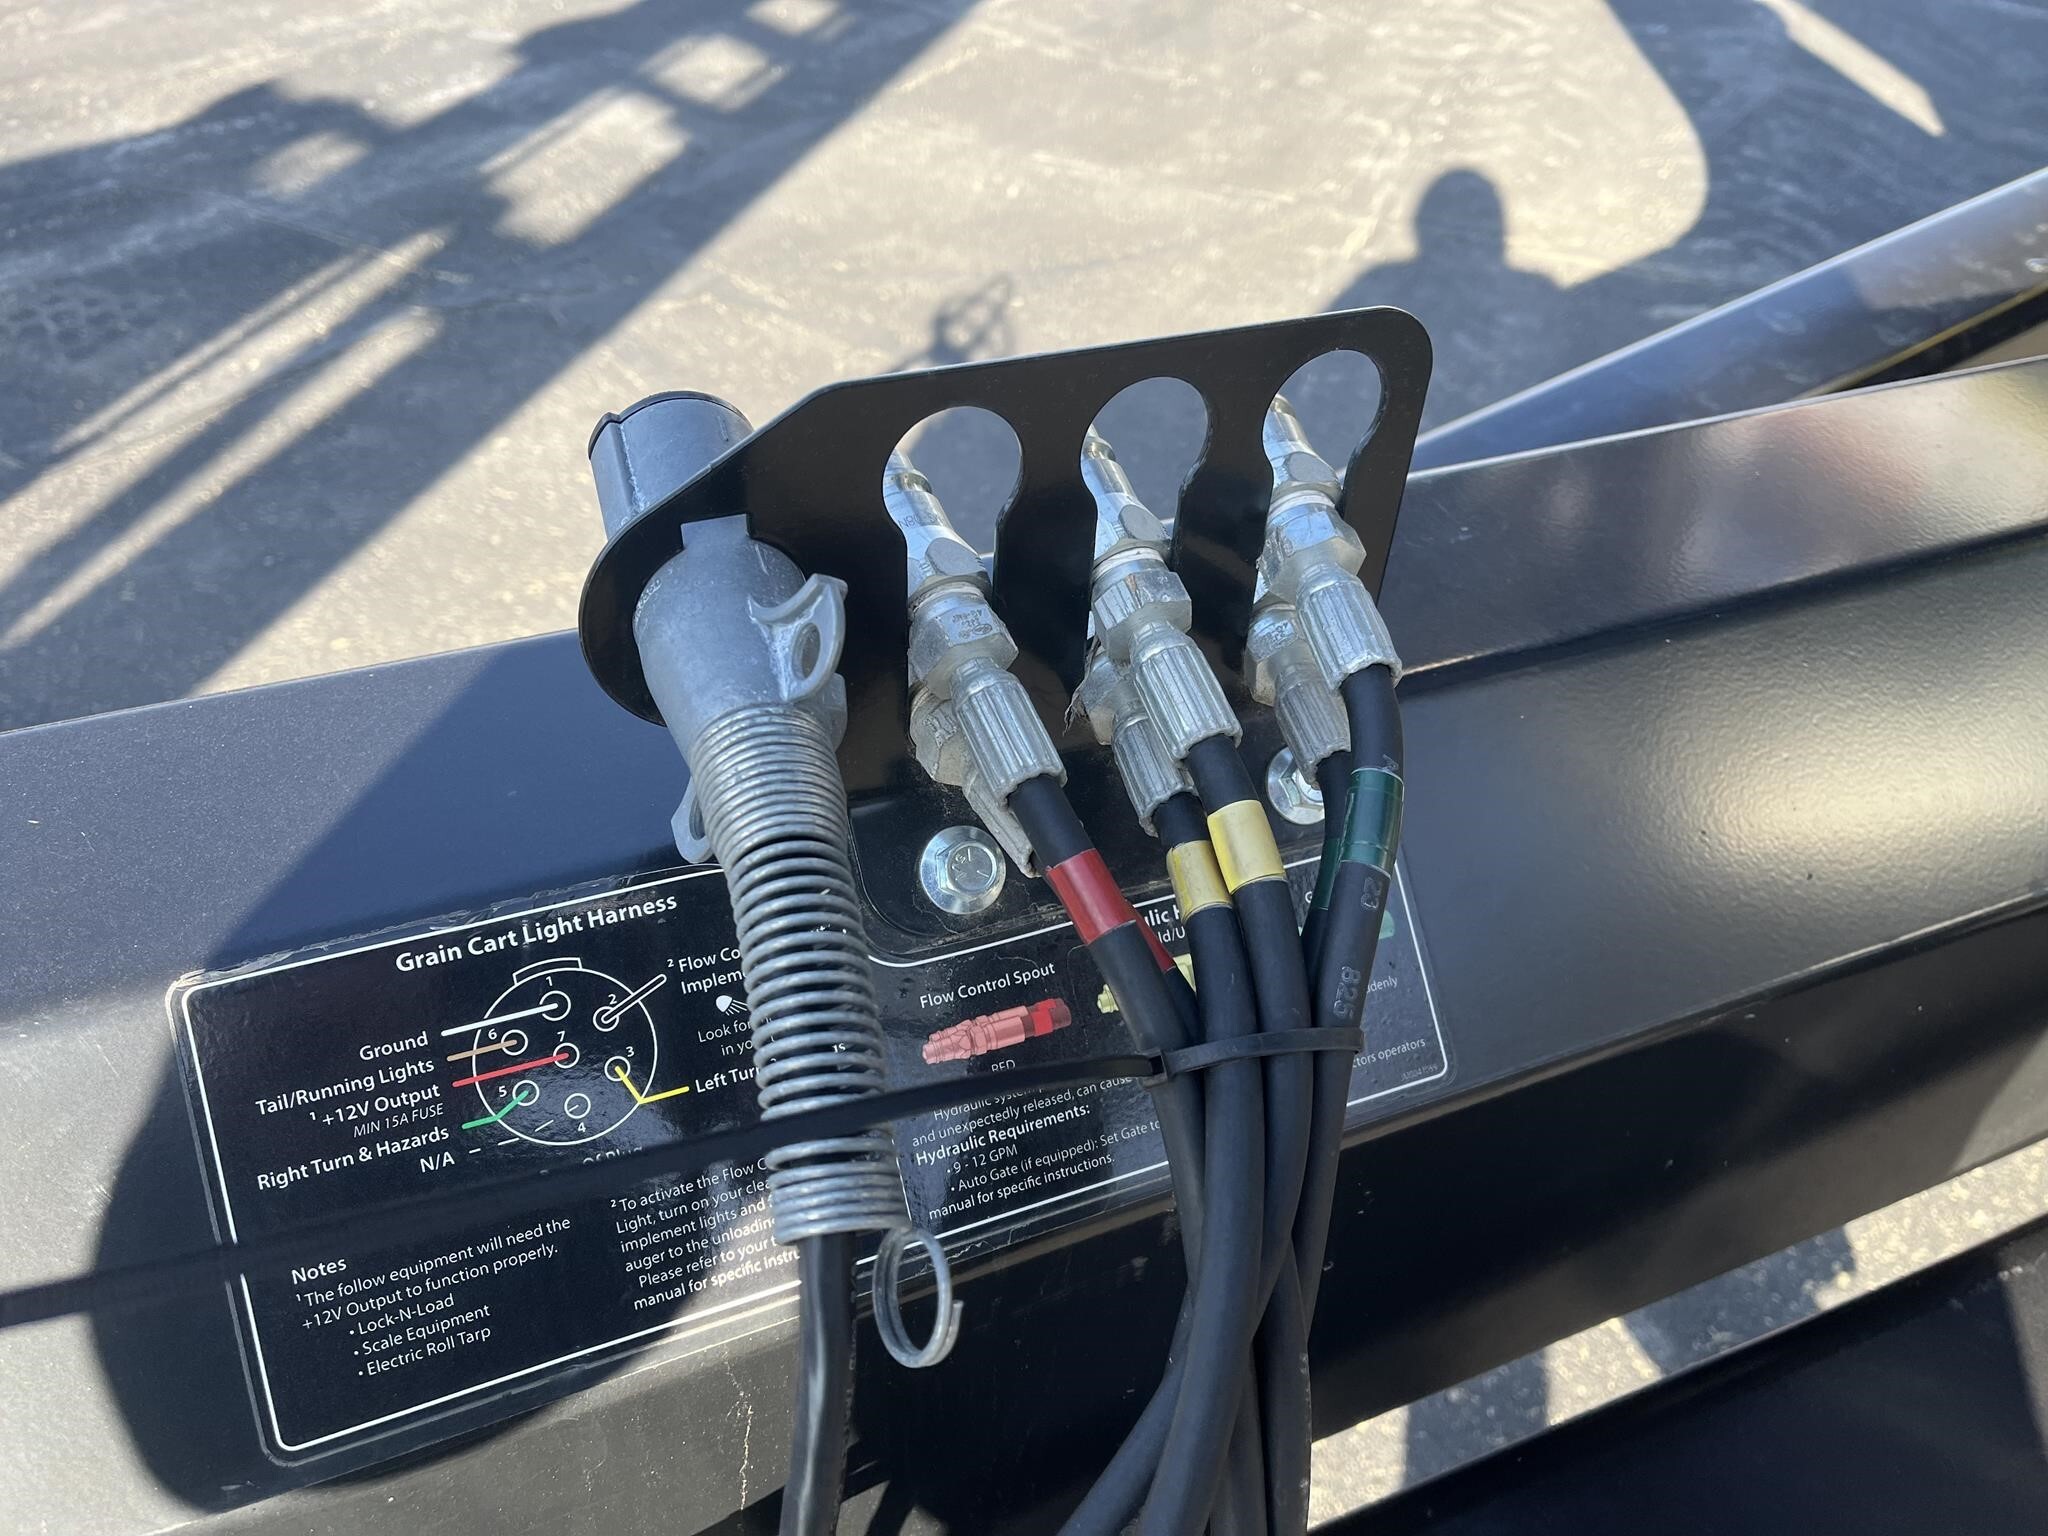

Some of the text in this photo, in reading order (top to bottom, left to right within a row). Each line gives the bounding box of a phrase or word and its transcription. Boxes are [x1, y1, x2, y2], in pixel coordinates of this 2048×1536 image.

[396, 896, 677, 971] Grain Cart Light Harness
[678, 954, 716, 972] Flow
[720, 947, 740, 961] Co
[546, 976, 553, 986] 1
[608, 994, 617, 1004] 2
[681, 969, 745, 994] Implem
[920, 962, 1055, 1009] Flow Control Spout
[360, 1031, 428, 1060] Ground
[488, 1028, 497, 1040] 6
[557, 1031, 565, 1042] 7
[626, 1047, 634, 1057] 3
[698, 1024, 731, 1042] Look
[721, 1040, 752, 1056] in yo
[1378, 1038, 1426, 1062] operators
[255, 1059, 434, 1115] Tail/Running Lights
[499, 1086, 507, 1097] 5
[695, 1073, 727, 1093] Left
[322, 1101, 369, 1126] +12V
[374, 1084, 440, 1112] Output
[354, 1103, 444, 1137] MIN 15A FUSE
[912, 1130, 936, 1147] and
[939, 1104, 1020, 1141] unexpectedly
[1023, 1089, 1075, 1114] released,
[1076, 1083, 1097, 1097] can
[577, 1122, 586, 1132] 4
[915, 1103, 1091, 1166] Hydraulic Requirements:
[257, 1126, 449, 1190] Right Turn & Hazards
[420, 1151, 455, 1172] N/A
[953, 1161, 962, 1174] 9
[971, 1155, 987, 1169] 12
[989, 1144, 1018, 1163] GPM
[958, 1174, 987, 1192] Auto
[990, 1165, 1019, 1183] Gate
[1020, 1158, 1034, 1173] (if
[1034, 1138, 1099, 1170] equipped):
[1099, 1131, 1119, 1147] Set
[1120, 1123, 1148, 1140] Gate
[619, 1198, 637, 1212] To
[640, 1183, 694, 1206] activate
[697, 1175, 719, 1193] the
[722, 1164, 754, 1182] Flow
[929, 1153, 1116, 1220] manual for specific instructions.
[616, 1214, 656, 1234] Light,
[658, 1206, 688, 1221] turn
[691, 1197, 709, 1211] on
[712, 1189, 743, 1210] your
[620, 1221, 697, 1253] implement
[700, 1208, 737, 1229] lights
[740, 1198, 765, 1217] and
[304, 1287, 335, 1307] The
[337, 1274, 386, 1298] follow
[389, 1246, 475, 1282] equipment
[476, 1235, 503, 1254] will
[505, 1224, 543, 1247] need
[545, 1218, 571, 1236] the
[625, 1217, 775, 1273] auger to the unloadin
[638, 1267, 683, 1288] Please
[686, 1256, 718, 1274] refer
[720, 1250, 735, 1263] to
[737, 1240, 769, 1263] your
[291, 1258, 347, 1285] Notes
[302, 1243, 559, 1330] +12V Output to function properly.
[633, 1283, 687, 1311] manual
[688, 1275, 708, 1293] for
[710, 1260, 762, 1288] specific
[358, 1293, 455, 1336] Lock-N-Load
[362, 1304, 491, 1356] Scale Equipment
[366, 1326, 491, 1377] Electric Roll Tarp
